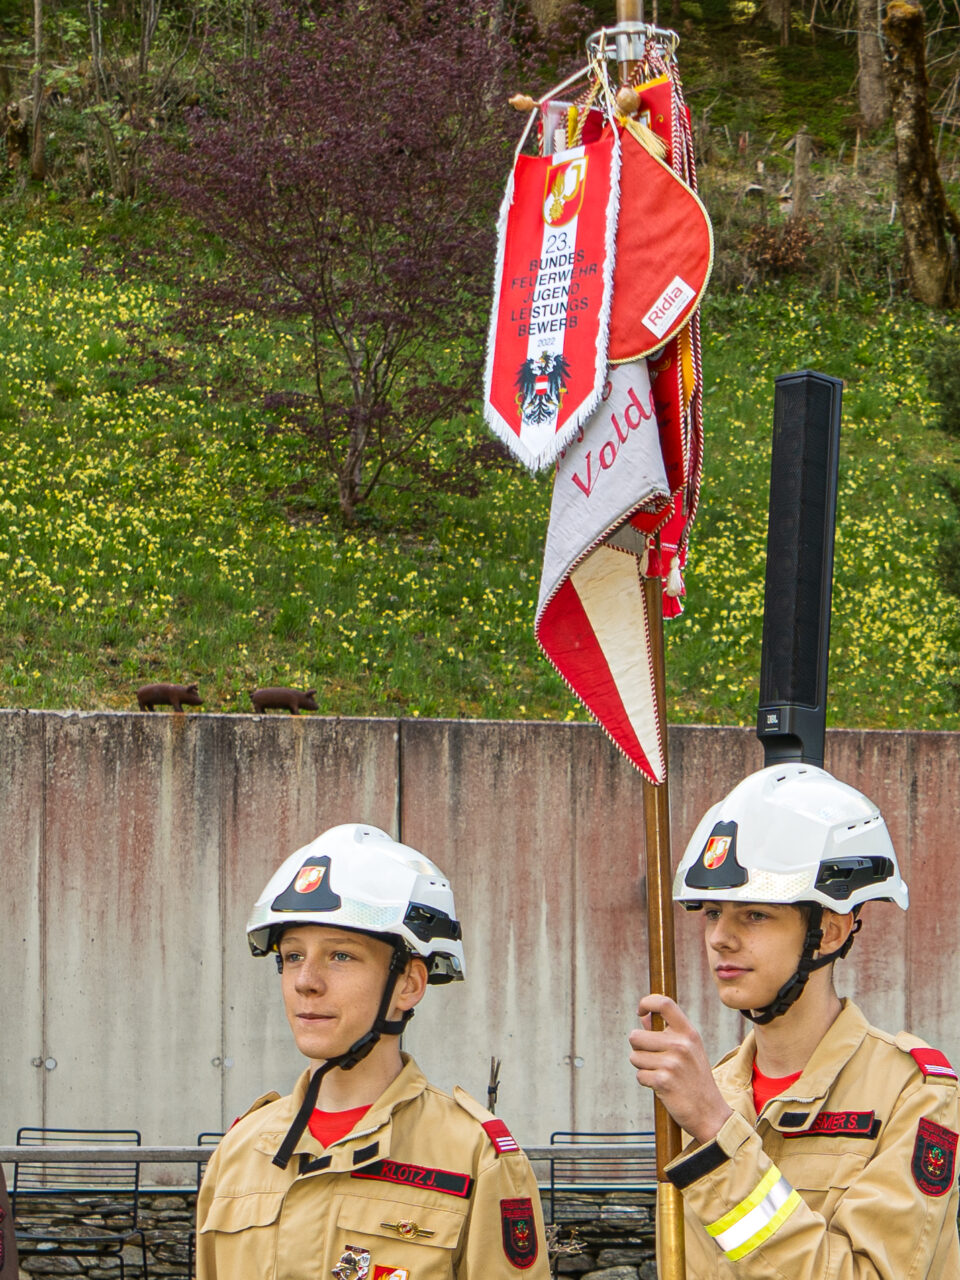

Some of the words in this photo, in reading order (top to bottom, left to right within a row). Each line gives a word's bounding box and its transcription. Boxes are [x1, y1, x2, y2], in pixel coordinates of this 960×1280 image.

[545, 232, 571, 254] 23.
[529, 249, 585, 272] BUNDES
[512, 263, 598, 290] FEUERWEHR
[523, 282, 580, 304] JUGEND
[511, 297, 589, 322] LEISTUNGS
[648, 286, 684, 327] Ridia
[518, 315, 578, 337] BEWERB
[815, 1114, 847, 1130] SMER
[380, 1162, 426, 1185] KLOTZ
